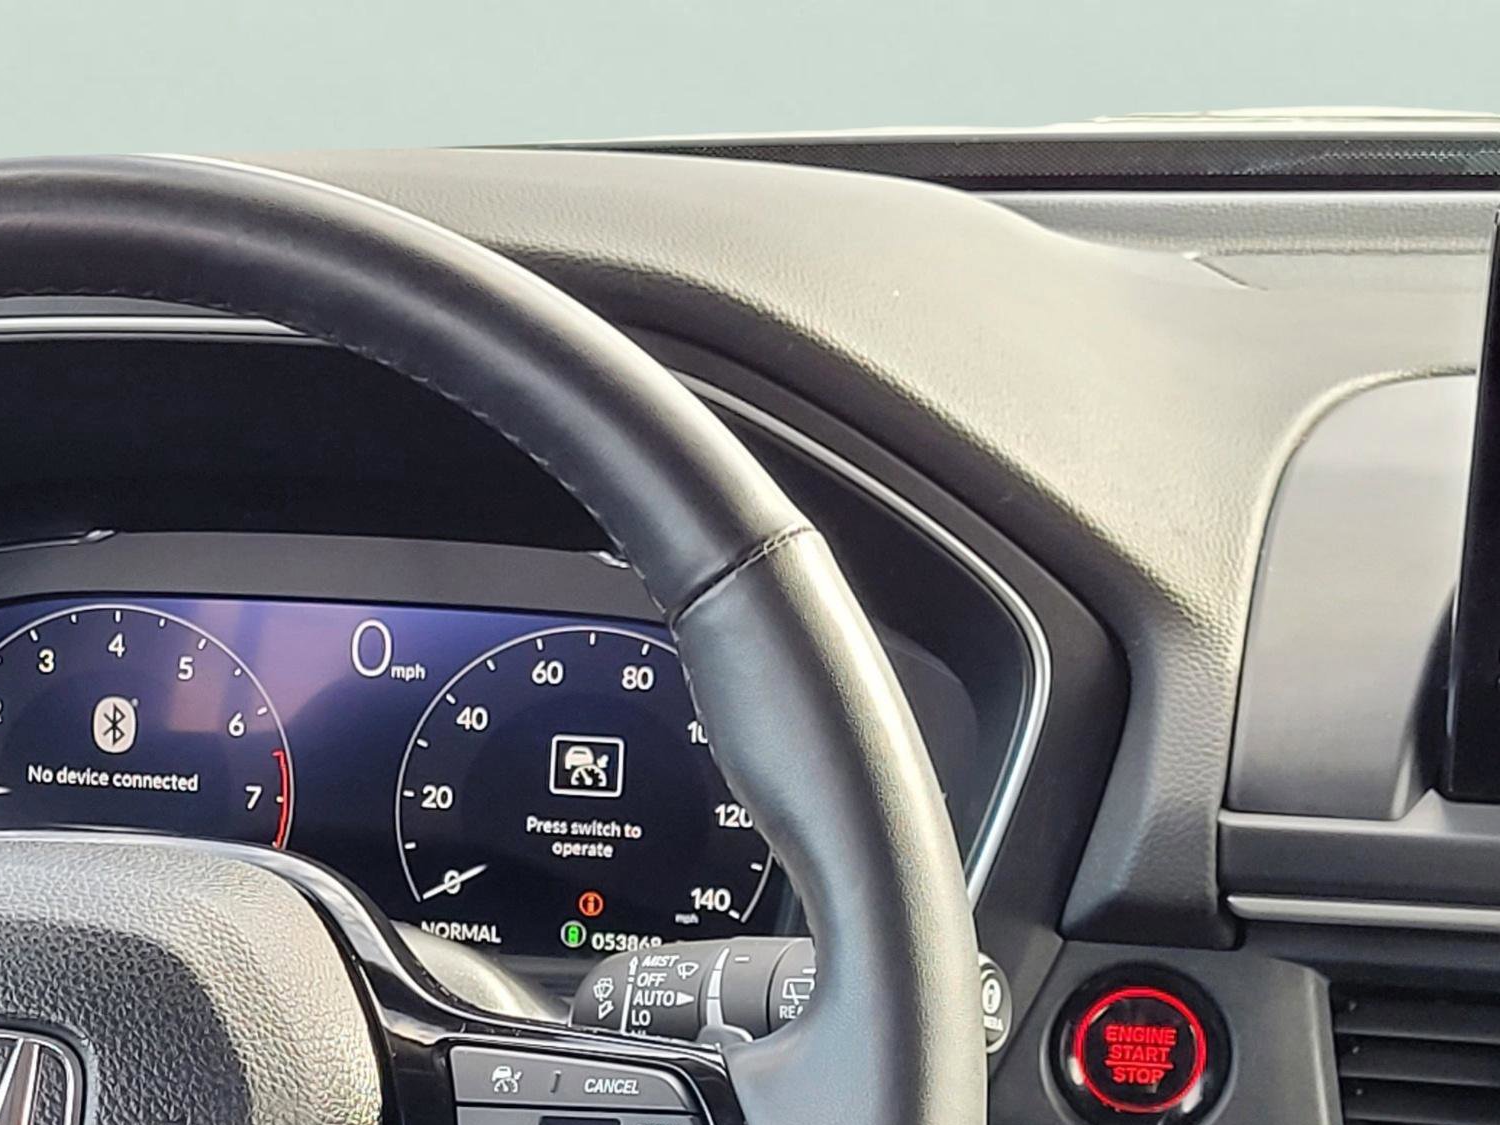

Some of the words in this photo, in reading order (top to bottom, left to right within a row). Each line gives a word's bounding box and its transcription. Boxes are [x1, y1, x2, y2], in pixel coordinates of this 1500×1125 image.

[108, 633, 125, 657] 4
[351, 618, 393, 678] 0
[390, 663, 426, 681] mph
[38, 649, 55, 673] 3
[177, 656, 195, 680] 5
[531, 660, 564, 685] 60
[621, 665, 654, 690] 80
[228, 712, 246, 738] 6
[455, 706, 489, 731] 40
[27, 764, 53, 783] No
[56, 766, 109, 786] device
[112, 773, 199, 793] connected
[245, 785, 263, 810] 7
[421, 785, 454, 810] 20
[526, 815, 568, 835] Press
[570, 820, 621, 838] switch
[623, 823, 642, 839] to
[551, 841, 614, 858] operate
[690, 887, 732, 912] 140
[420, 920, 502, 944] NORMAL
[641, 955, 679, 968] MIST
[636, 973, 668, 987] OFF
[633, 990, 675, 1007] AUTO
[631, 1009, 651, 1026] LO
[1105, 1026, 1177, 1046] ENGINE
[1111, 1045, 1171, 1063] START
[584, 1078, 640, 1095] CANCEL
[1112, 1067, 1165, 1084] STOP
